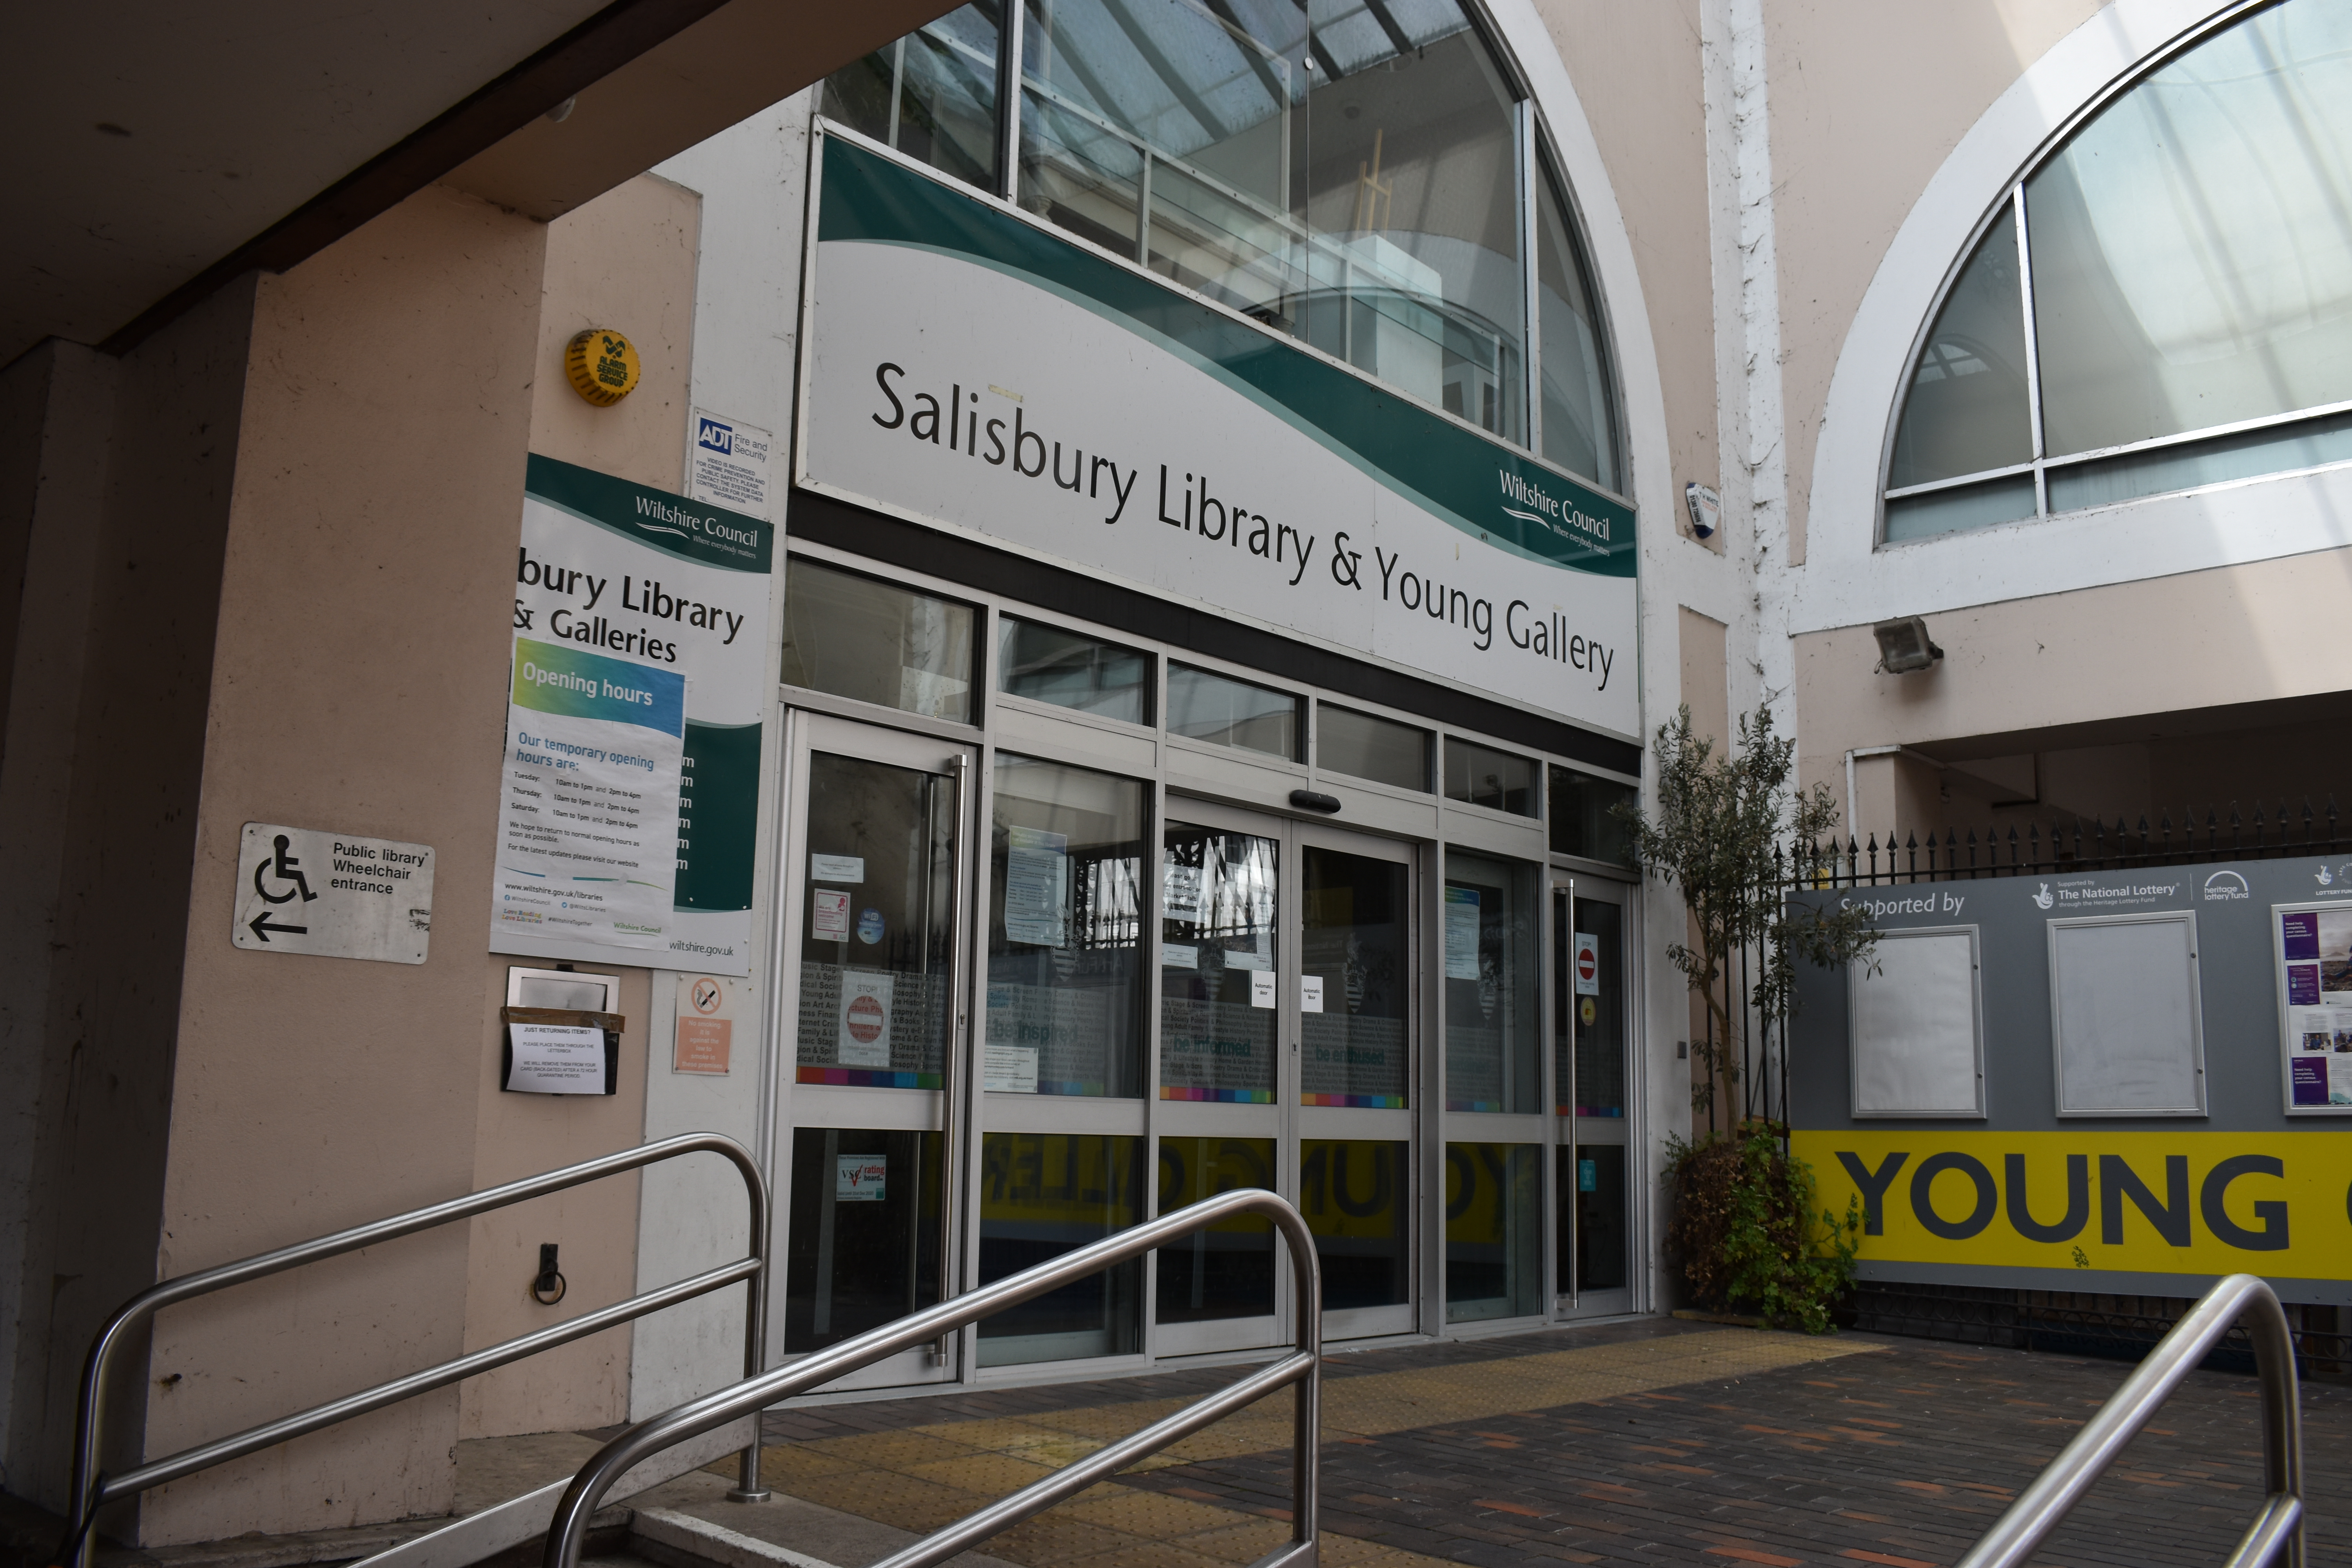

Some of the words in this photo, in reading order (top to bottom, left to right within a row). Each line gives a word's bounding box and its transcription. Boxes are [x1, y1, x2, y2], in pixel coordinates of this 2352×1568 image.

[597, 364, 628, 381] SERVICE
[600, 356, 626, 372] ALARM
[599, 374, 624, 388] GROUP
[699, 424, 732, 450] ADT
[735, 433, 750, 446] Fire
[752, 441, 767, 451] and
[734, 443, 766, 463] Security
[707, 457, 722, 466] VIDEO
[728, 464, 755, 475] RECORDED
[707, 463, 722, 472] CRIME
[724, 468, 754, 481] PREVENTION
[696, 473, 719, 483] CONTACT
[731, 483, 750, 492] SYSTEM
[701, 468, 719, 477] PUBLIC
[740, 480, 759, 489] PLEASE
[696, 479, 729, 492] CONTROLLER
[740, 492, 763, 503] FURTHER
[713, 490, 746, 503] INFORMATION
[1500, 469, 1559, 517] Wiltshire
[1563, 501, 1609, 541] Council
[636, 496, 701, 530] Wiltshire
[705, 518, 758, 547] Council
[872, 362, 1137, 524] Salisbury
[1159, 464, 1315, 586] Library
[1331, 531, 1362, 590] &
[1374, 546, 1492, 651] Young
[1506, 600, 1614, 691] Gallery
[693, 535, 710, 545] Where
[711, 541, 737, 555] everybody
[738, 549, 756, 559] matters
[1553, 524, 1569, 538] Where
[1570, 532, 1593, 551] everybody
[1593, 544, 1610, 557] matters
[622, 575, 744, 645] Library
[513, 599, 534, 630] &
[550, 609, 677, 663] Galleries
[523, 662, 596, 697] Opening
[603, 679, 652, 705] hours
[516, 749, 552, 766] hours
[556, 759, 579, 771] are:
[519, 732, 541, 746] Our
[545, 739, 606, 762] temporary
[610, 753, 653, 771] opening
[514, 771, 540, 782] Tuesday:
[513, 787, 541, 798] Thursday:
[520, 823, 535, 831] hope
[592, 835, 615, 844] opening
[334, 842, 376, 860] Public
[382, 849, 425, 867] library
[333, 859, 411, 880] Wheelchair
[331, 878, 393, 894] entrance
[505, 884, 602, 900] www.wiltshire.gov.uk/libraries
[2058, 889, 2079, 900] The
[2083, 886, 2129, 898] National
[518, 910, 541, 919] Reading
[1943, 892, 1964, 916] by
[613, 922, 639, 930] Wiltshire
[670, 940, 733, 956] wiltshire.gov.uk
[1018, 1020, 1078, 1045] inspired
[1194, 1036, 1252, 1057] informed
[1333, 1046, 1385, 1066] enthused
[864, 1165, 885, 1175] rating
[1835, 1151, 2290, 1251] YOUNG
